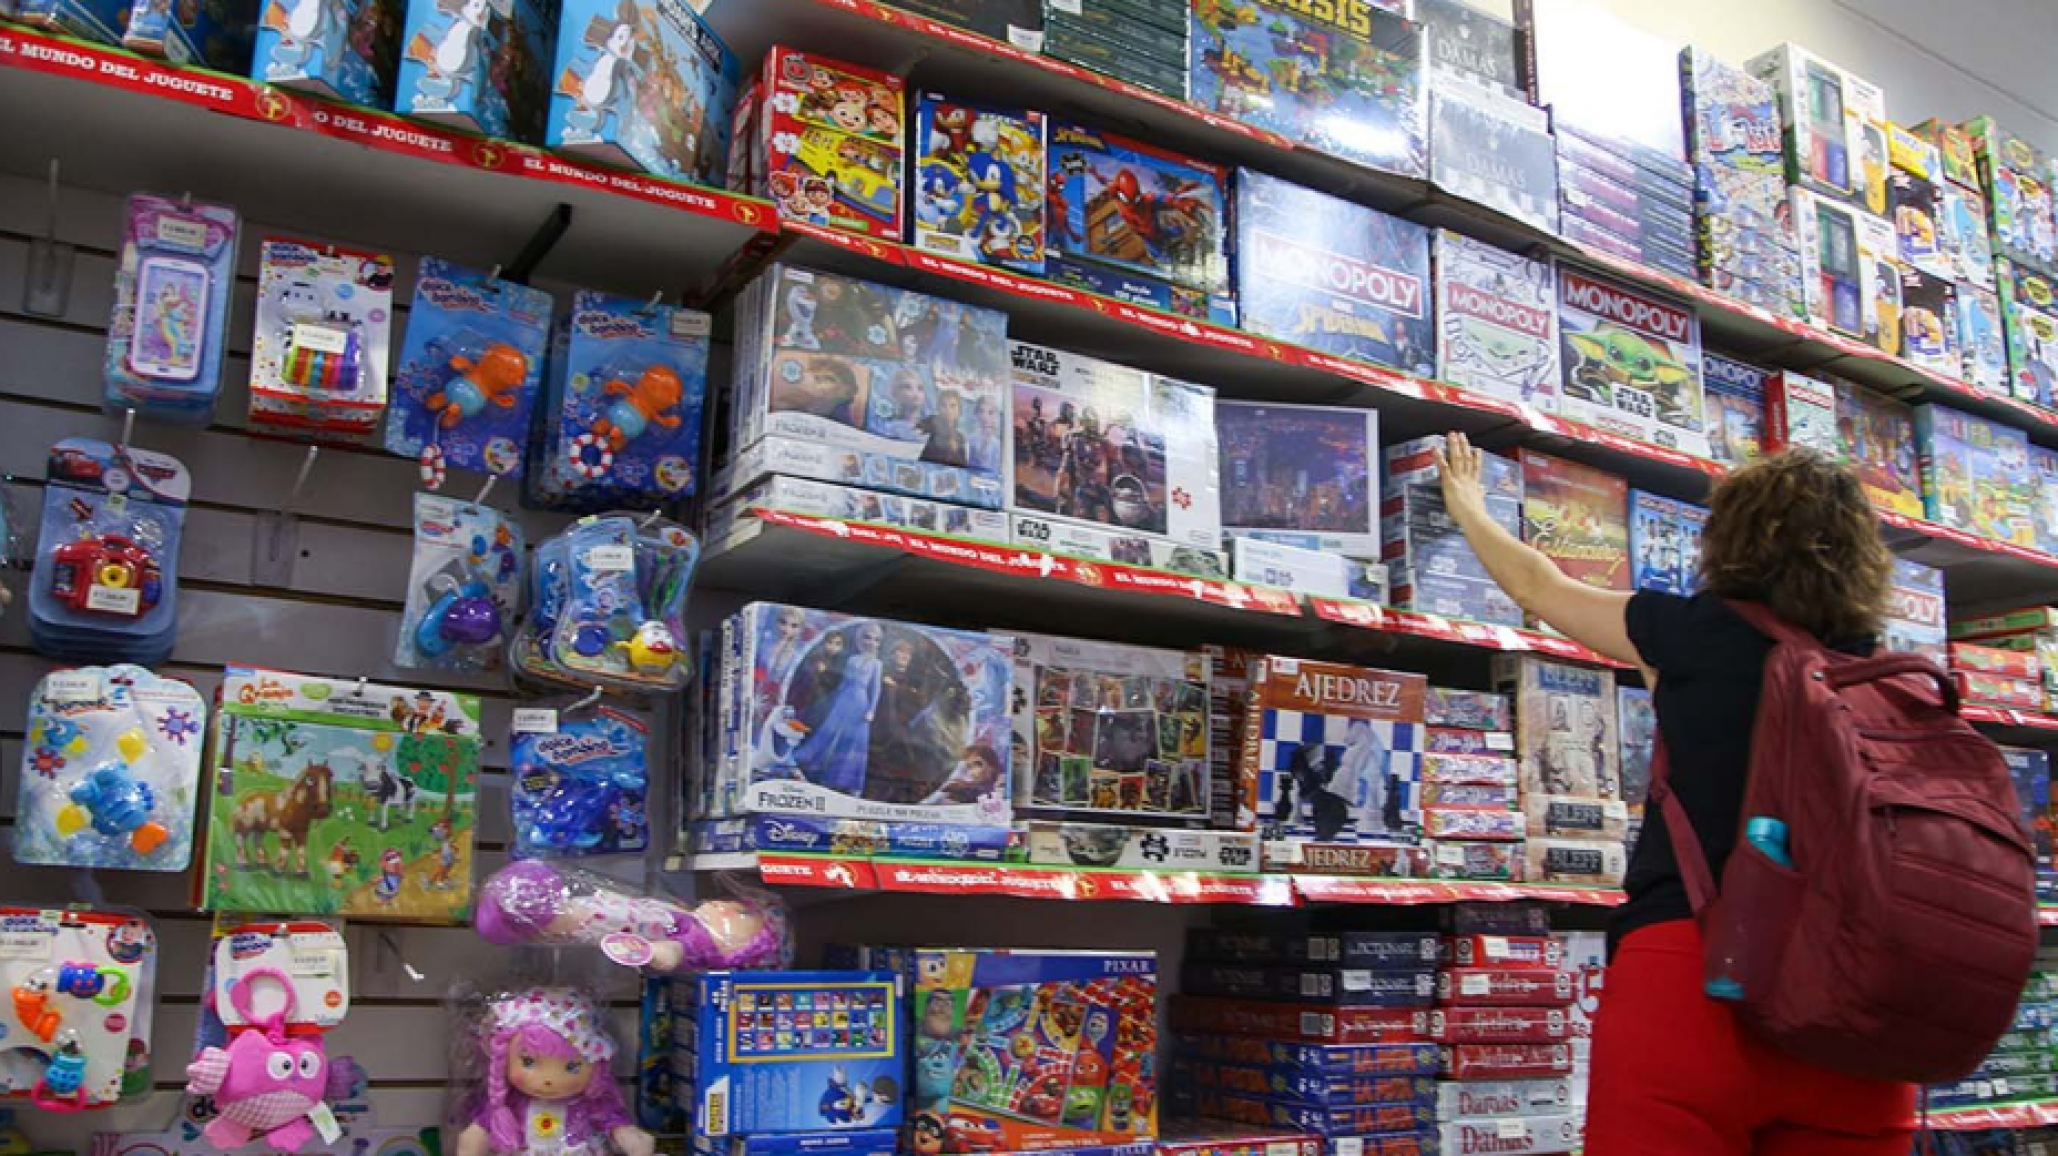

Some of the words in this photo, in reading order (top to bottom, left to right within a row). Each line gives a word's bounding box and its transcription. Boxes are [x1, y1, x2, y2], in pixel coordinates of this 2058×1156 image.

[20, 41, 95, 69] MUNDO
[100, 60, 140, 81] DEL
[143, 72, 233, 101] JUGUETE
[333, 115, 368, 133] DEL
[372, 125, 453, 151] JUGUETE
[523, 156, 545, 171] EL
[548, 162, 608, 183] MUNDO
[611, 176, 642, 192] DEL
[644, 185, 717, 209] JUGUETE
[1453, 288, 1547, 333] MONOPOLY
[1567, 280, 1687, 340] MONOPOLY
[1011, 345, 1057, 363] STAR
[1013, 357, 1060, 376] WARS
[1294, 672, 1401, 707] AJEDREZ
[758, 791, 816, 809] FROZEN
[1302, 849, 1370, 867] JEDREZ
[1103, 960, 1151, 974] PIXAR
[1458, 1091, 1519, 1115] Damas
